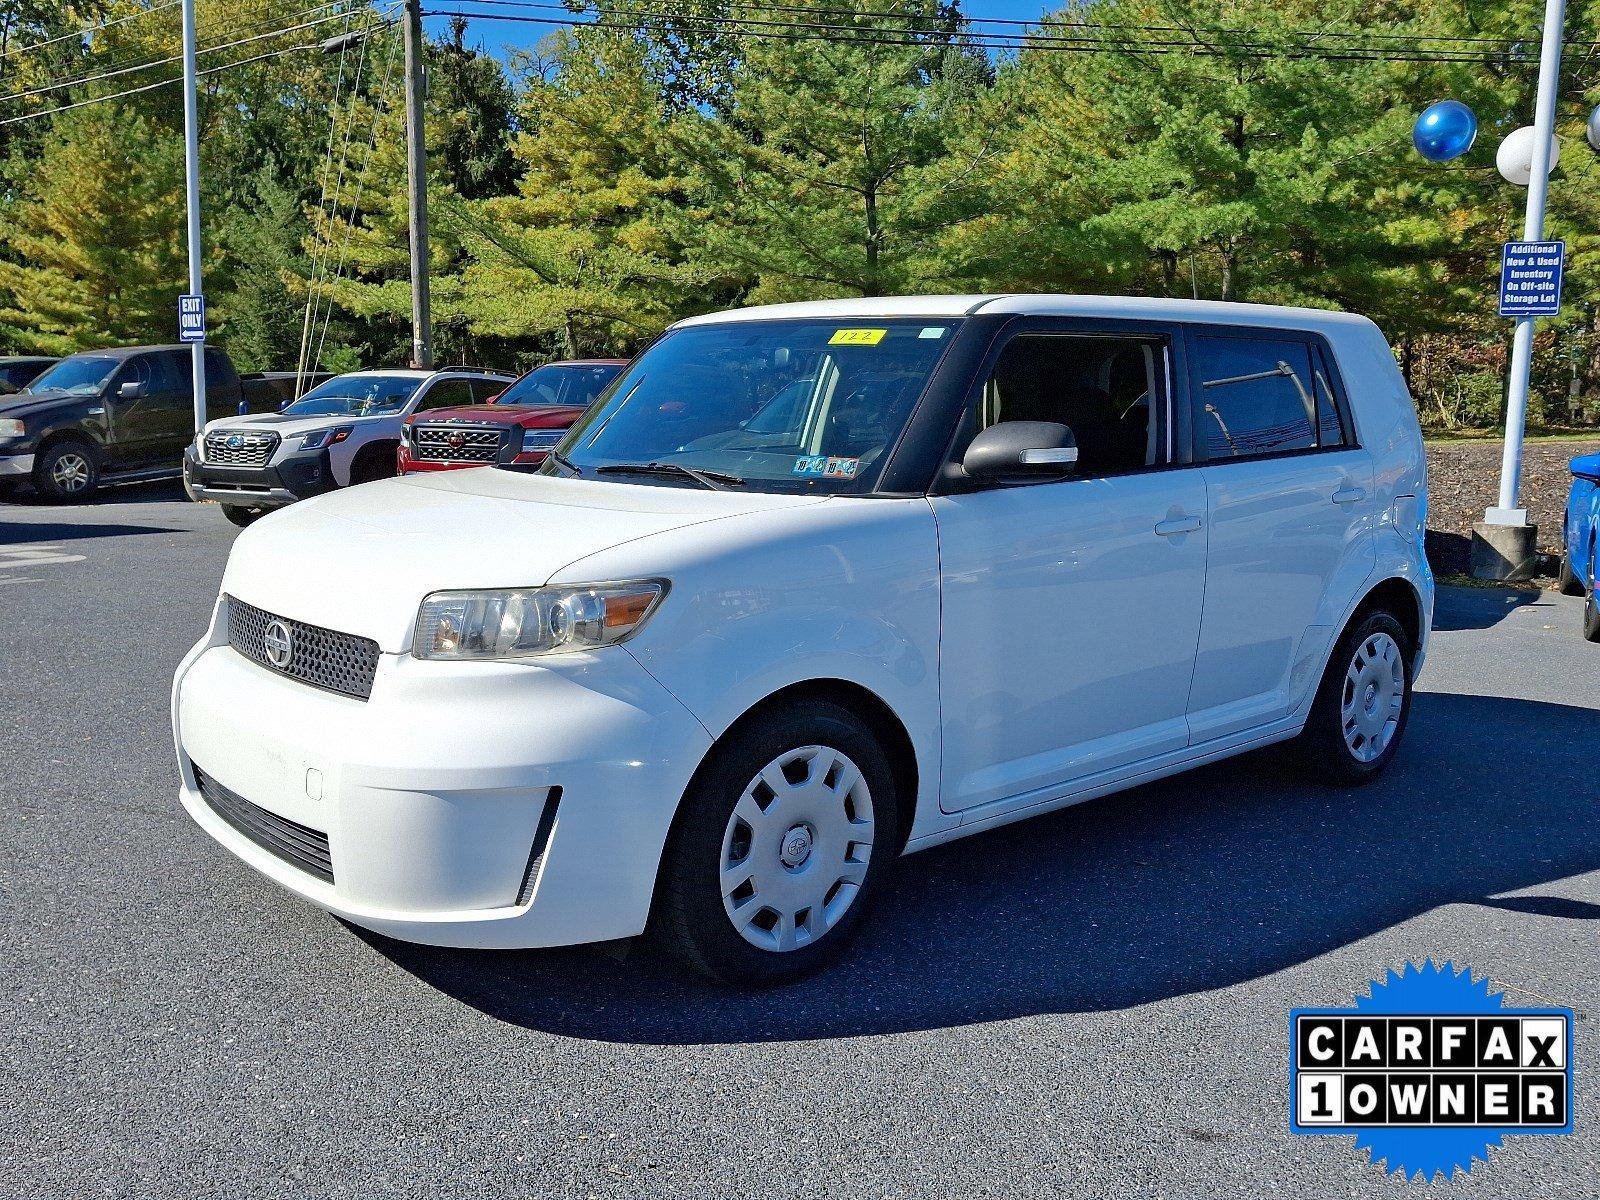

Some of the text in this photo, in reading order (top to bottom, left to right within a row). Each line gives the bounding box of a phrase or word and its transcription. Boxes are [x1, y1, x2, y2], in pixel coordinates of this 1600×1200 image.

[1510, 245, 1557, 254] Additional
[1506, 257, 1560, 266] New & Used
[1510, 270, 1553, 279] Inventory
[1507, 282, 1555, 291] On Off-site
[1504, 294, 1556, 304] Storage Lot
[182, 298, 200, 312] EXIT
[182, 313, 201, 327] ONLY
